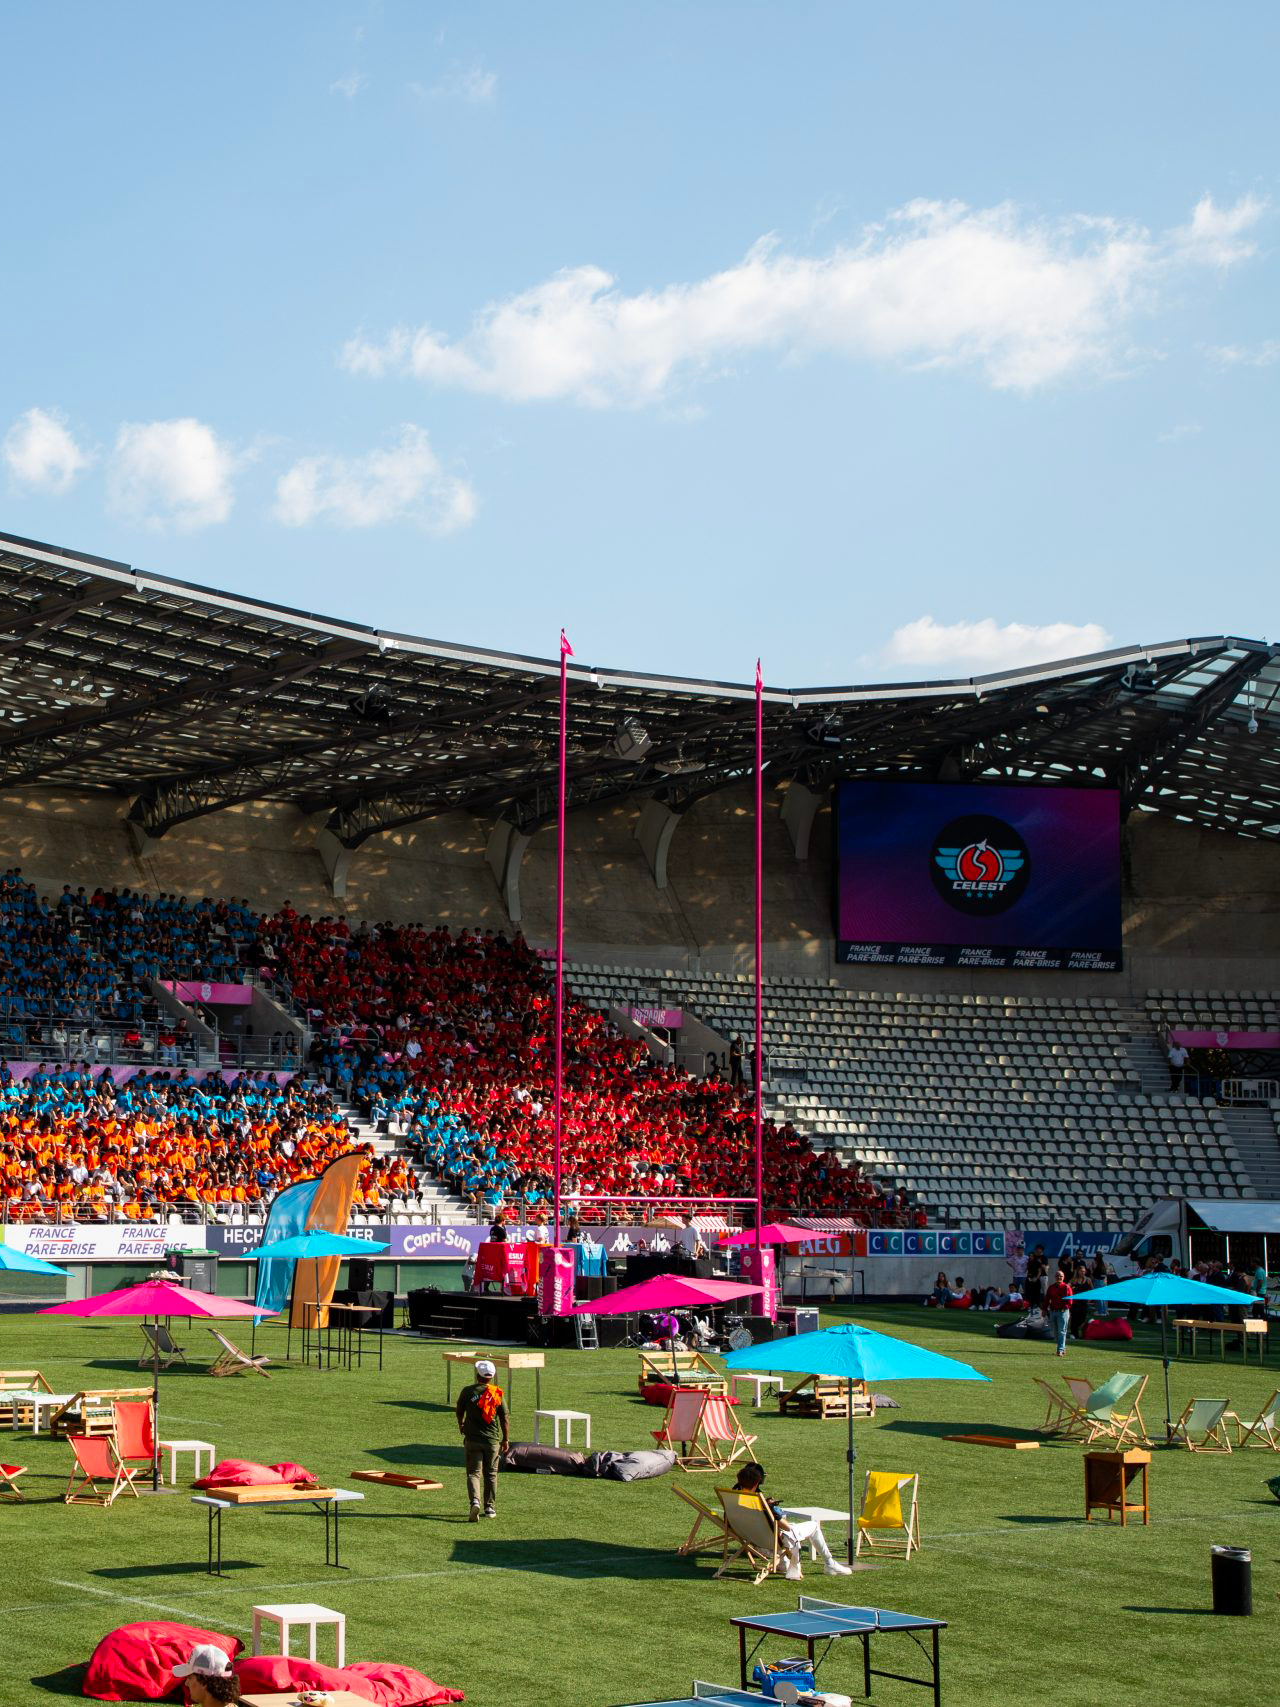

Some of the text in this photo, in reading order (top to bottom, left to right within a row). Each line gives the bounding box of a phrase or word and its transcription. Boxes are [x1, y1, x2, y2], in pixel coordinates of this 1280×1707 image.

[952, 881, 1007, 891] CELEST
[850, 945, 881, 953] FRANCE
[900, 947, 931, 955] FRANCE
[961, 948, 992, 956] FRANCE
[847, 954, 894, 963] PARE-BRISE
[1016, 950, 1047, 958] FRANCE
[1071, 952, 1102, 960] FRANCE
[897, 955, 944, 964] PARE-BRISE
[958, 957, 1005, 966] PARE-BRISE
[1013, 959, 1060, 968] PARE-BRISE
[1068, 960, 1115, 969] PARE-BRISE
[29, 1228, 76, 1238] FRANCE
[122, 1228, 167, 1238] FRANCE
[403, 1228, 471, 1253] Capri-Sun
[872, 1235, 900, 1251] CIC
[907, 1235, 935, 1251] CIC
[941, 1235, 969, 1251] CIC
[974, 1235, 1002, 1251] CIC
[24, 1243, 96, 1255] PARE-BRISE
